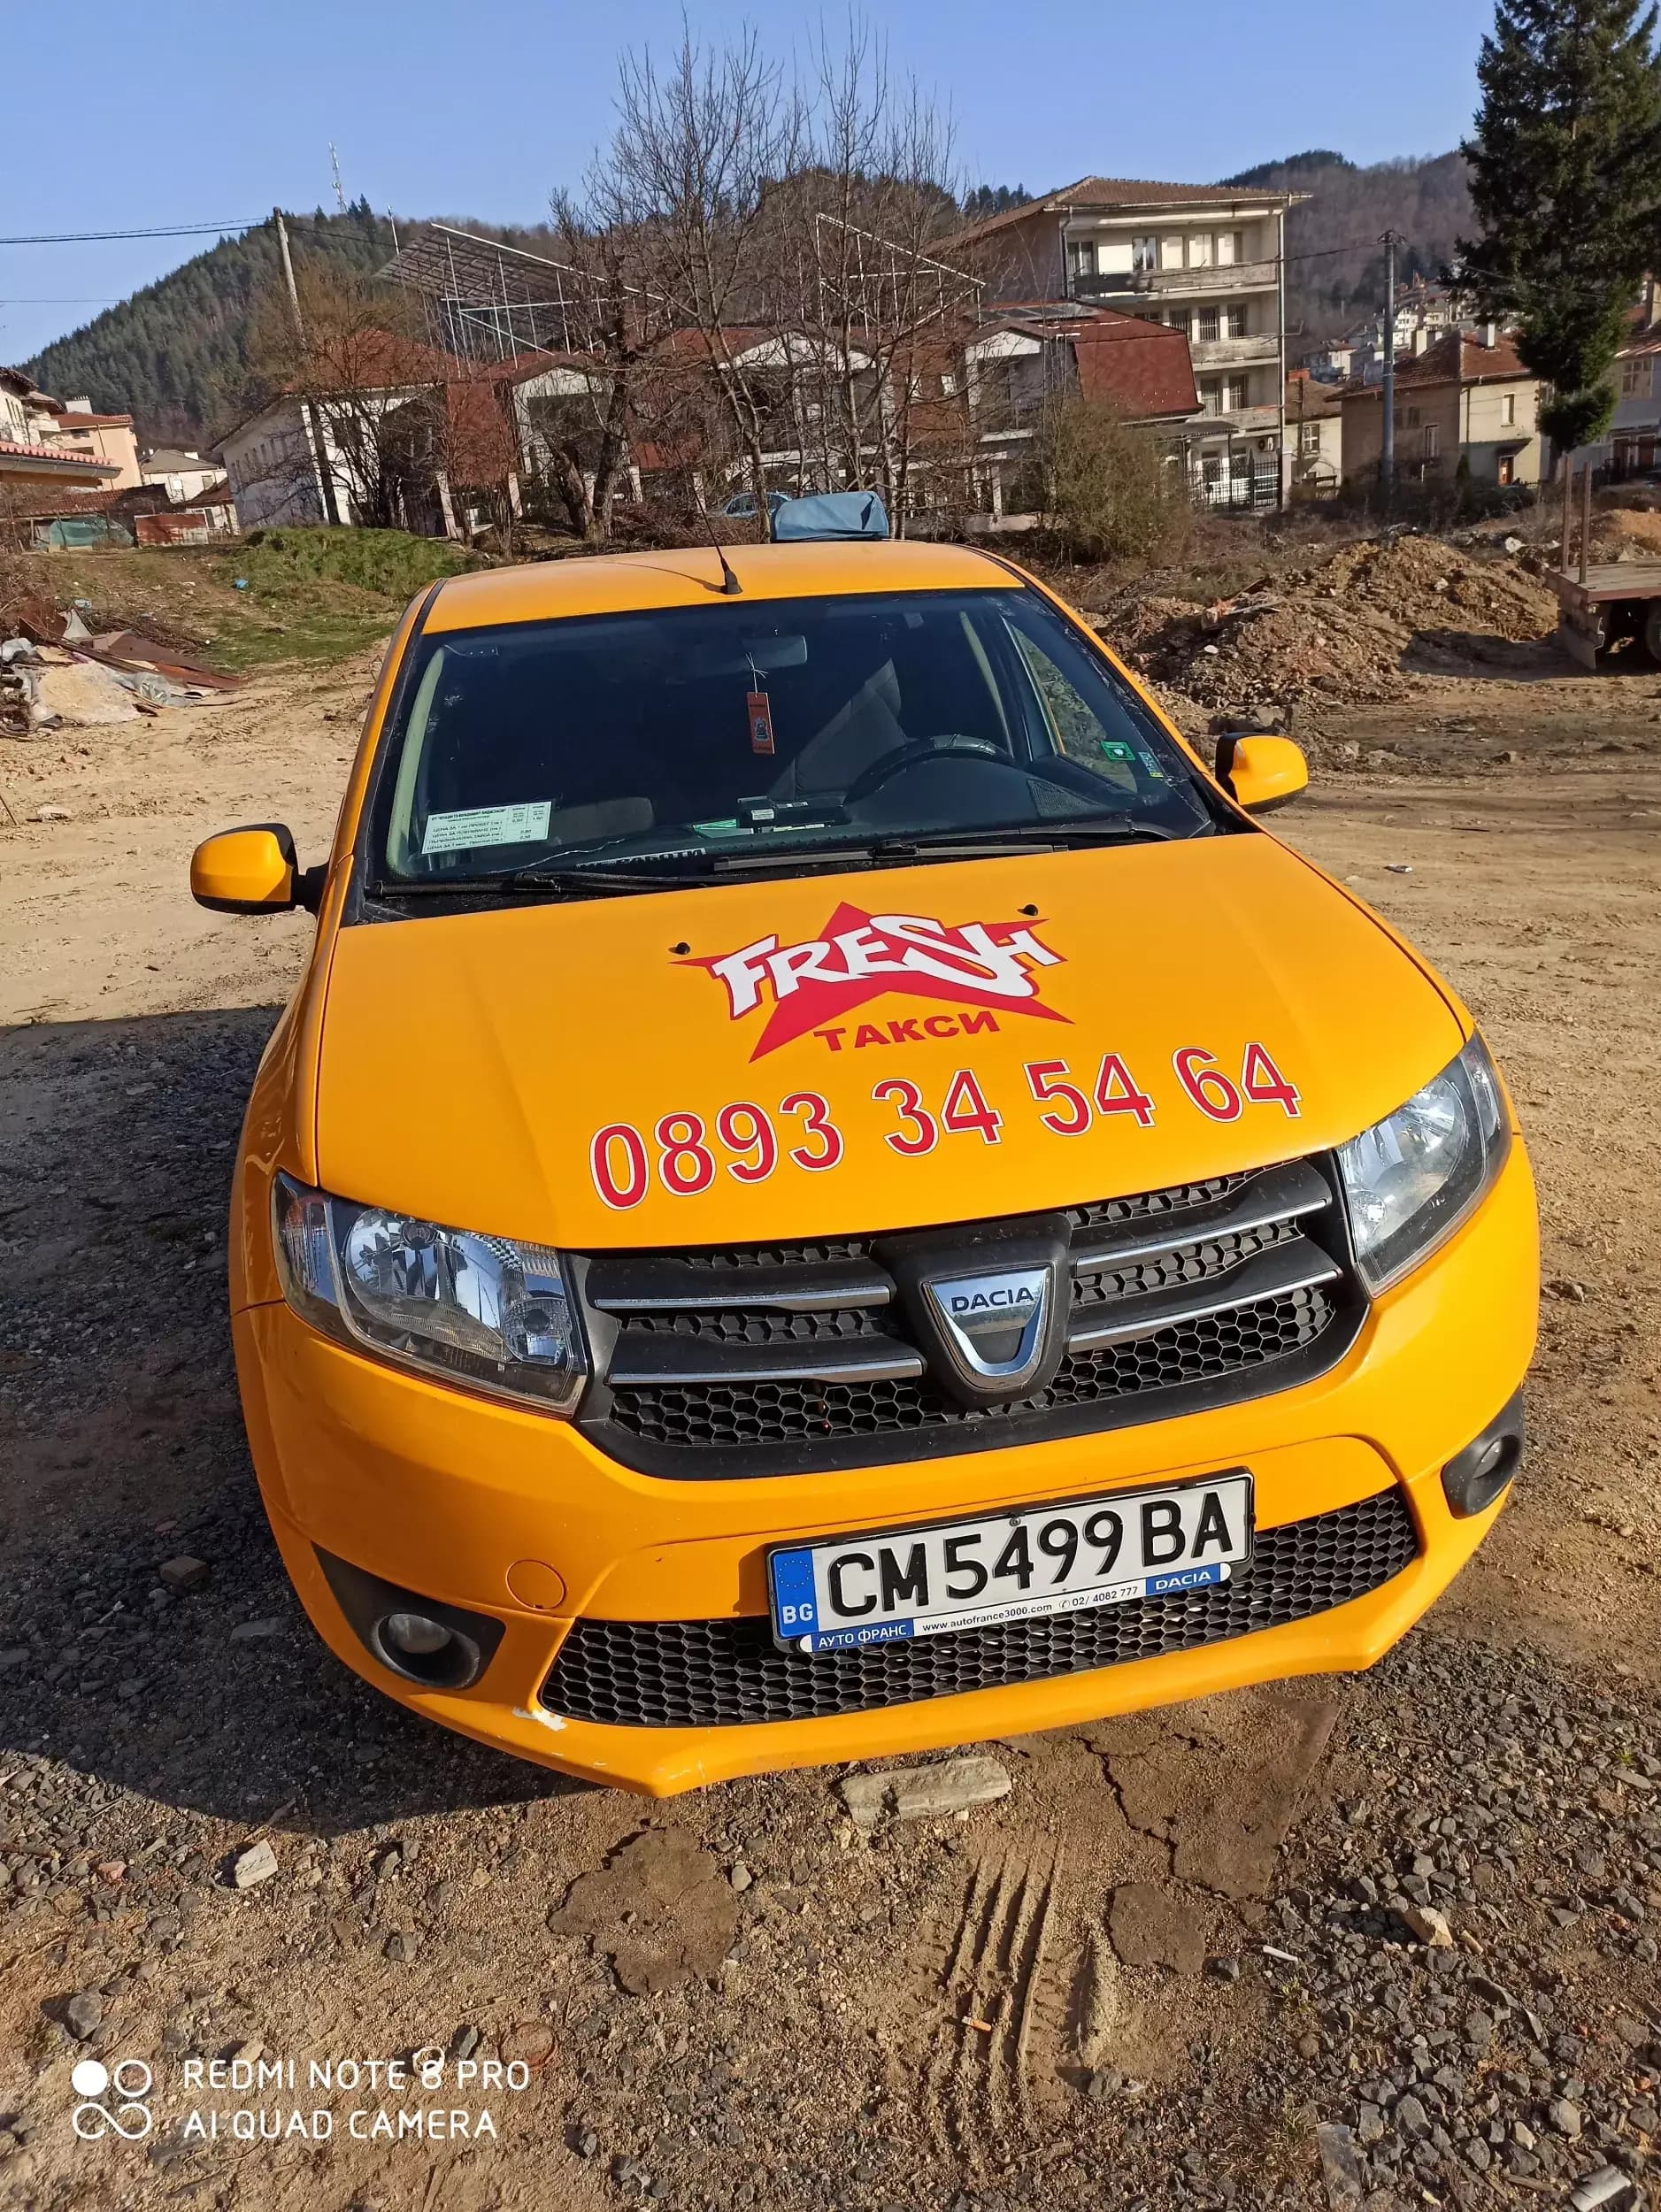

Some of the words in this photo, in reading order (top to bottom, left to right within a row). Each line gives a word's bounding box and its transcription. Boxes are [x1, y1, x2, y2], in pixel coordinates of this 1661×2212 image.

[711, 913, 1061, 1019] FRESH
[813, 1010, 1000, 1053] ТАКСИ
[588, 1090, 845, 1210] 0893
[872, 1068, 1004, 1158] 34
[1026, 1052, 1157, 1137] 54
[1172, 1041, 1303, 1123] 64
[950, 1287, 1034, 1312] DACIA
[1155, 1571, 1211, 1590] DACIA
[782, 1603, 813, 1624] BG
[922, 1603, 1052, 1632] www.autofrance3000.com
[1092, 1590, 1118, 1602] 4082
[1120, 1586, 1138, 1597] 777
[819, 1633, 854, 1648] АУТО
[857, 1624, 907, 1643] ФРАНС
